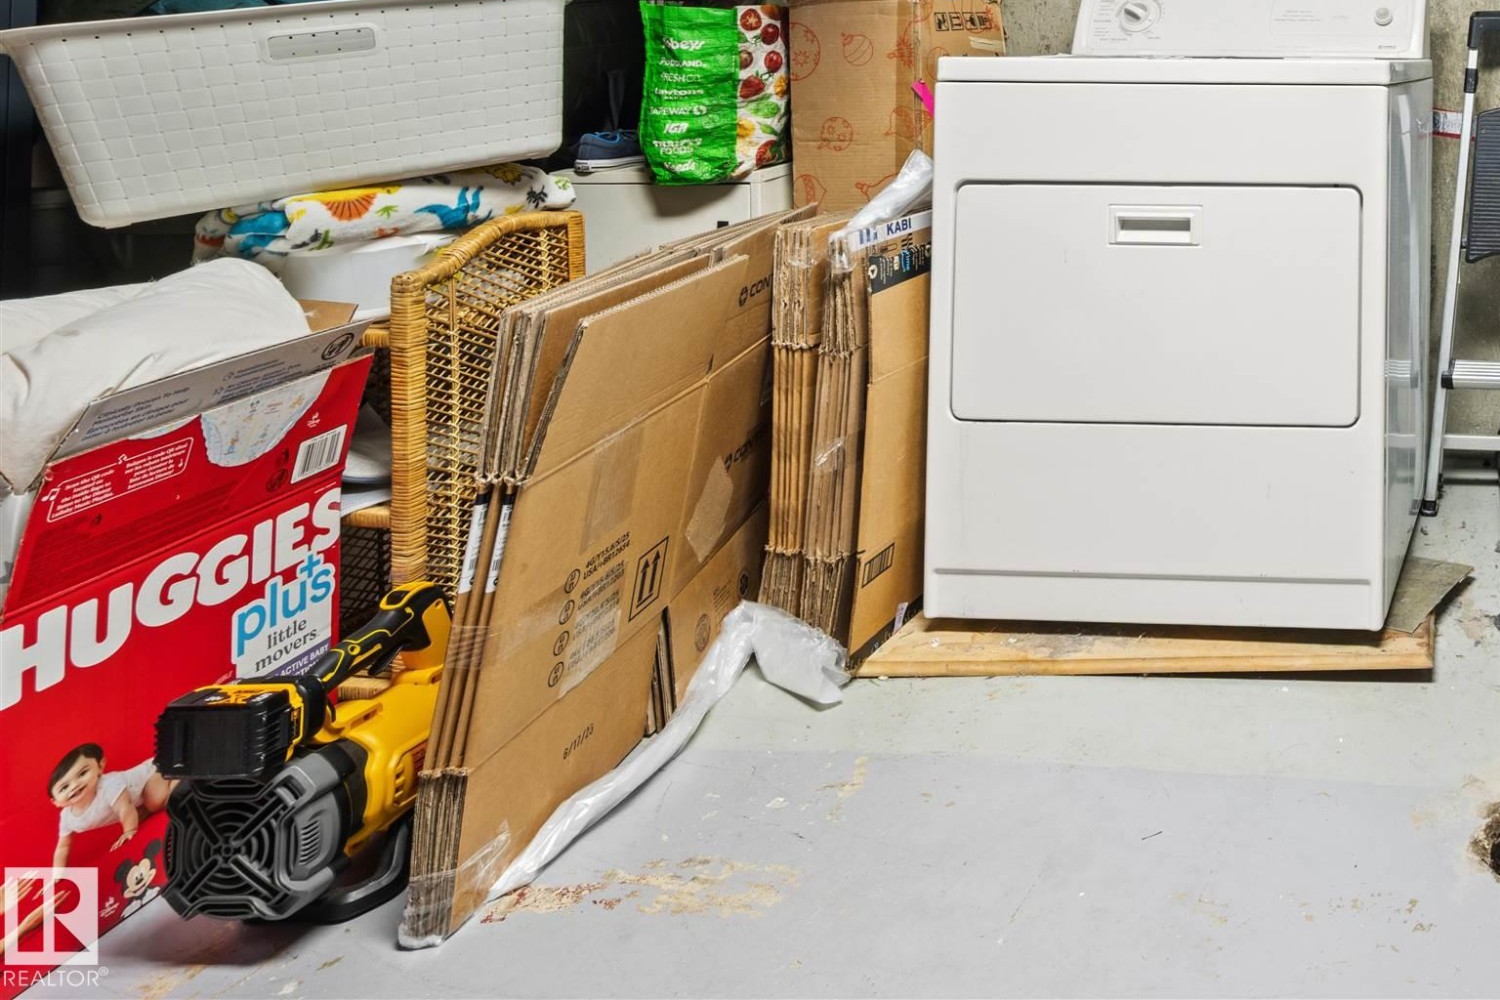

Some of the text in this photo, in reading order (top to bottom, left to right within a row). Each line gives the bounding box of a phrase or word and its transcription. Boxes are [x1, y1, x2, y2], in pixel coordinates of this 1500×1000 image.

[664, 122, 689, 134] IGA
[886, 218, 912, 235] KABI
[0, 487, 341, 712] HUGGIES
[237, 564, 332, 657] plus
[255, 628, 317, 672] movers
[267, 619, 307, 650] little
[280, 654, 309, 676] ACTIVE
[309, 643, 329, 661] BABY
